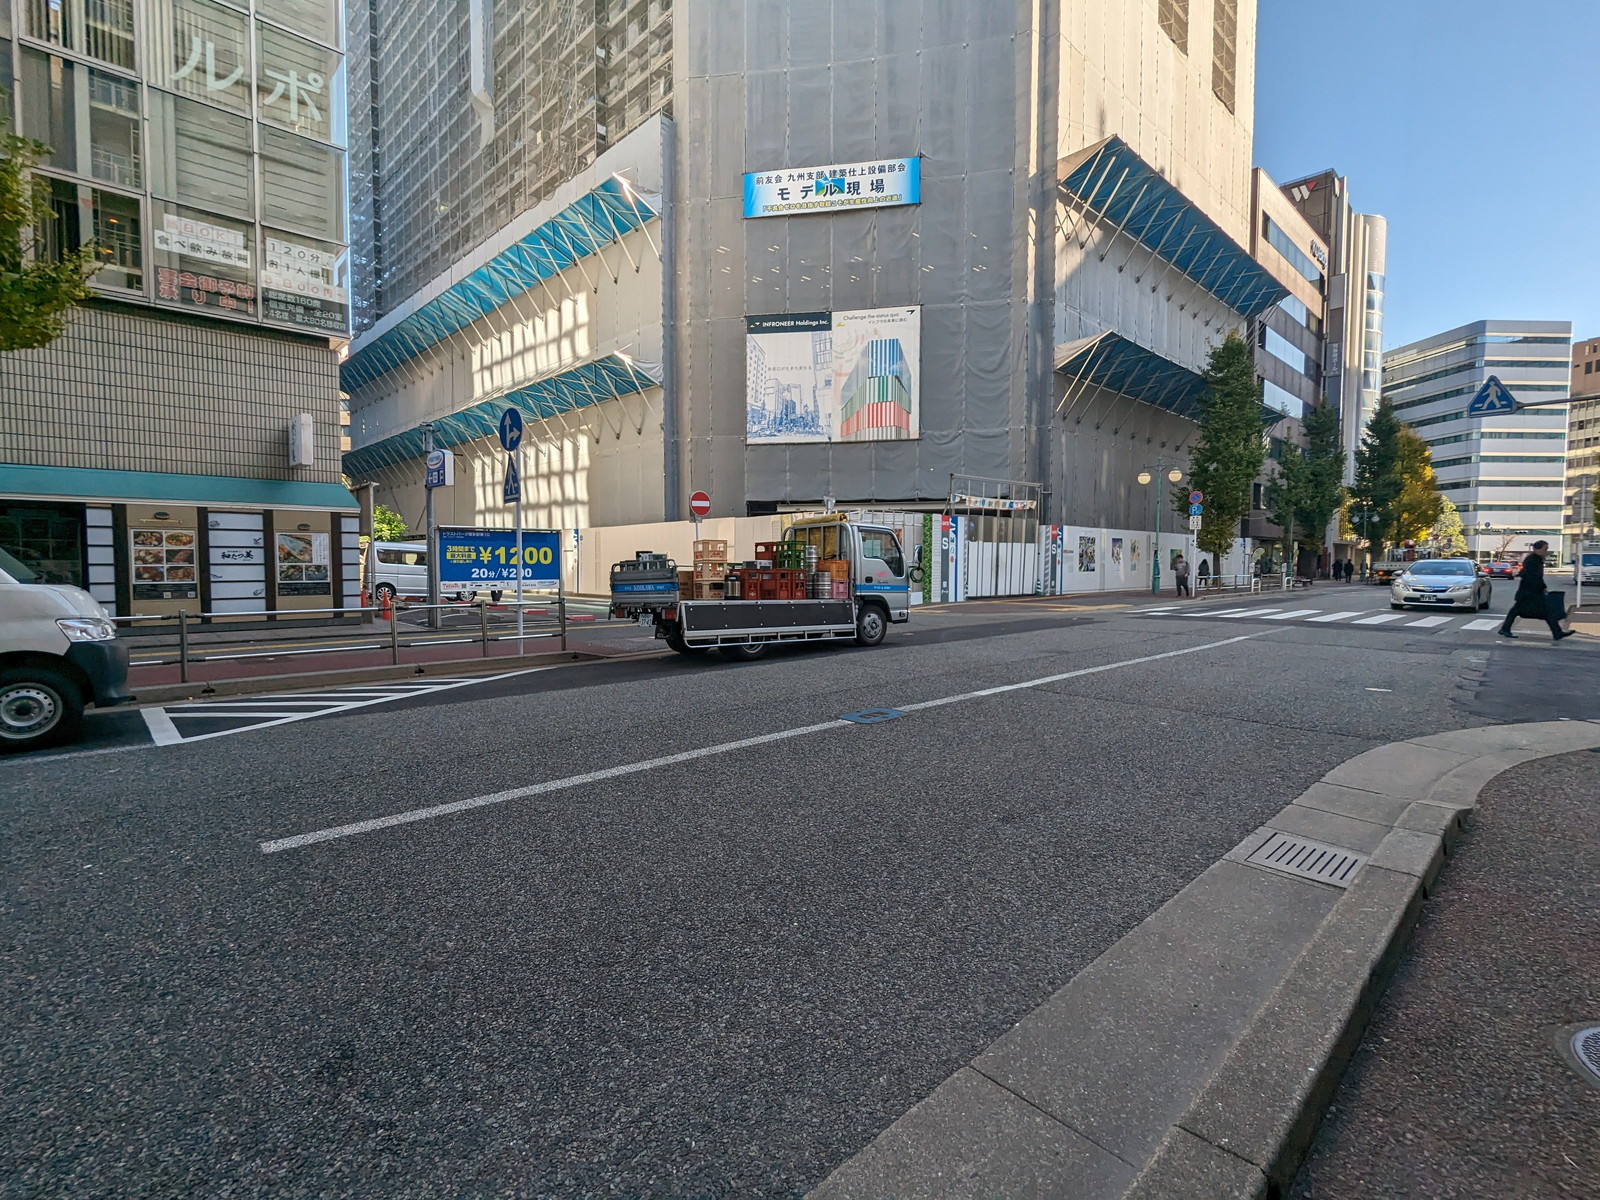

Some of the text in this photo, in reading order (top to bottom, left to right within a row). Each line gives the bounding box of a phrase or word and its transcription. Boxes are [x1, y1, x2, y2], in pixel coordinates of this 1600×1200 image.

[756, 163, 907, 186] 前友会 九州支部 建築仕上設備部会
[777, 179, 885, 201] モデル現場
[762, 318, 830, 328] INFRONEER Holdings Inc.
[843, 314, 867, 322] Challenge
